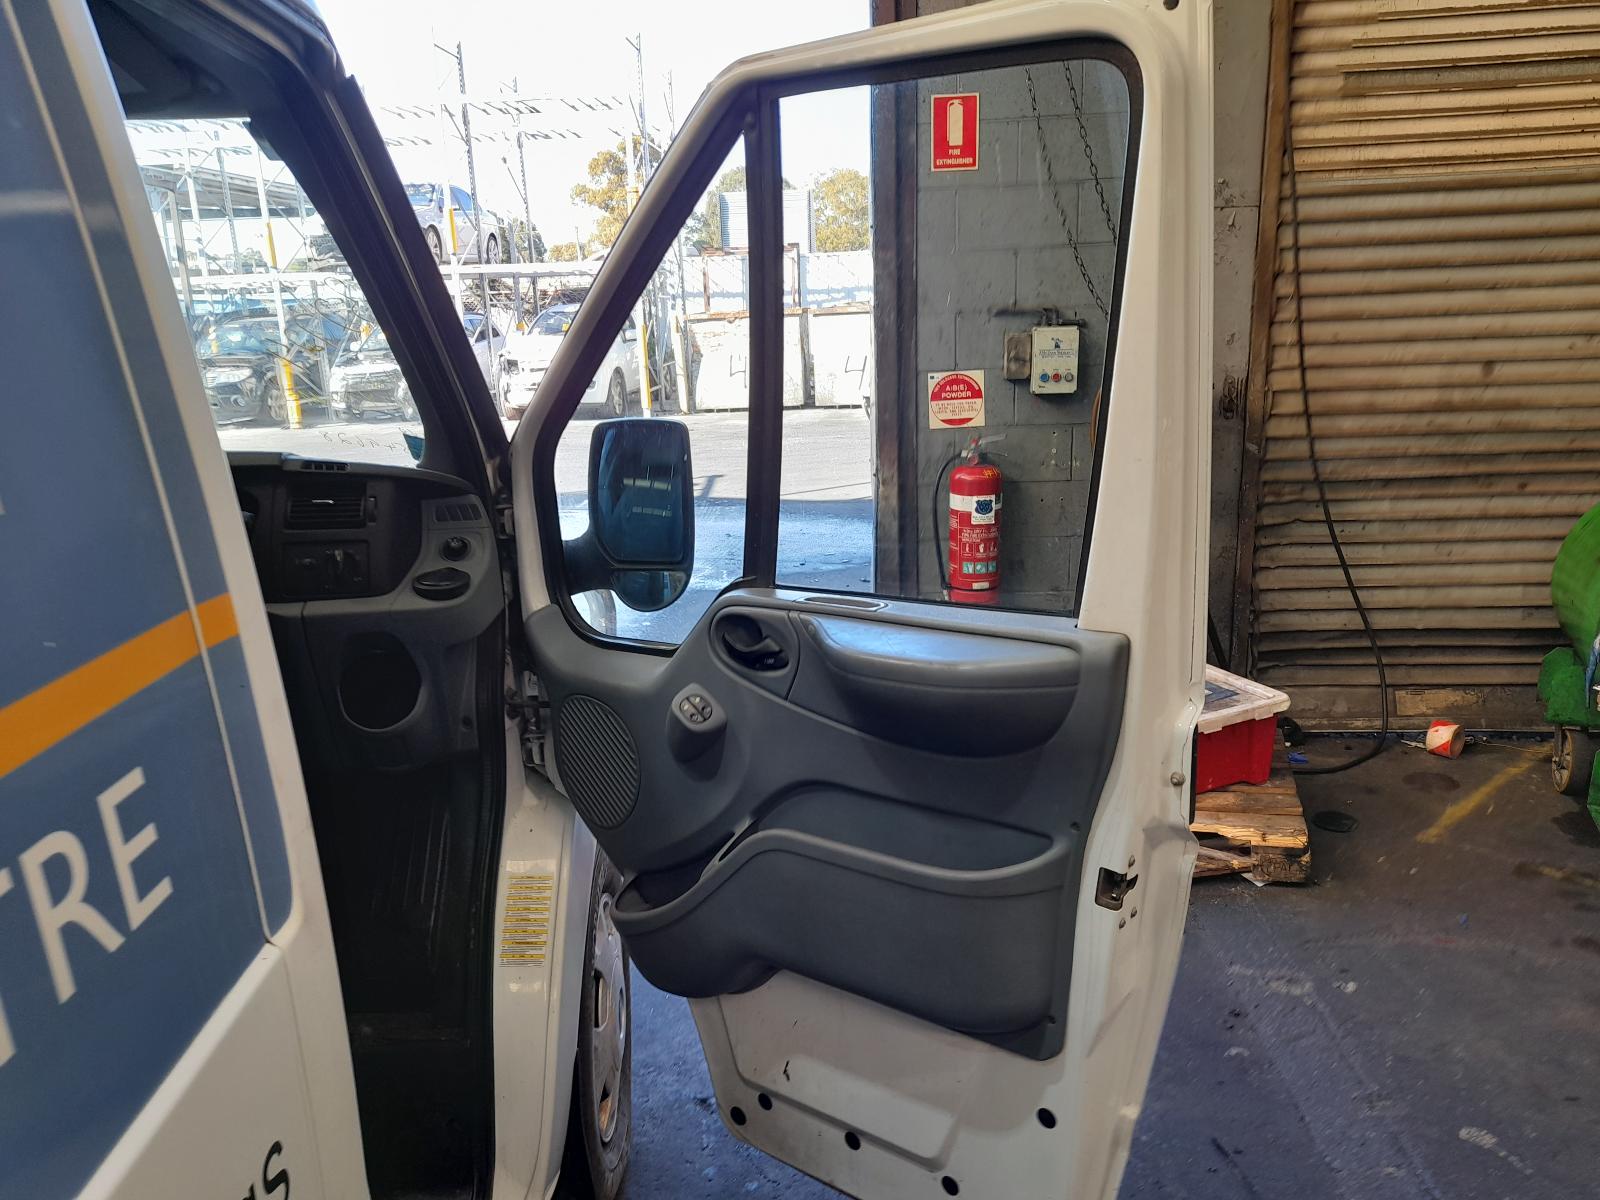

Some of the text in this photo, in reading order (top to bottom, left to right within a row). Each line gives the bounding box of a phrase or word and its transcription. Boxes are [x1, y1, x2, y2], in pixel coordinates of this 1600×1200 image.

[948, 148, 961, 156] FIRE
[936, 157, 974, 166] EXTINGUISHER
[844, 355, 868, 391] 4
[941, 390, 972, 399] POWDER
